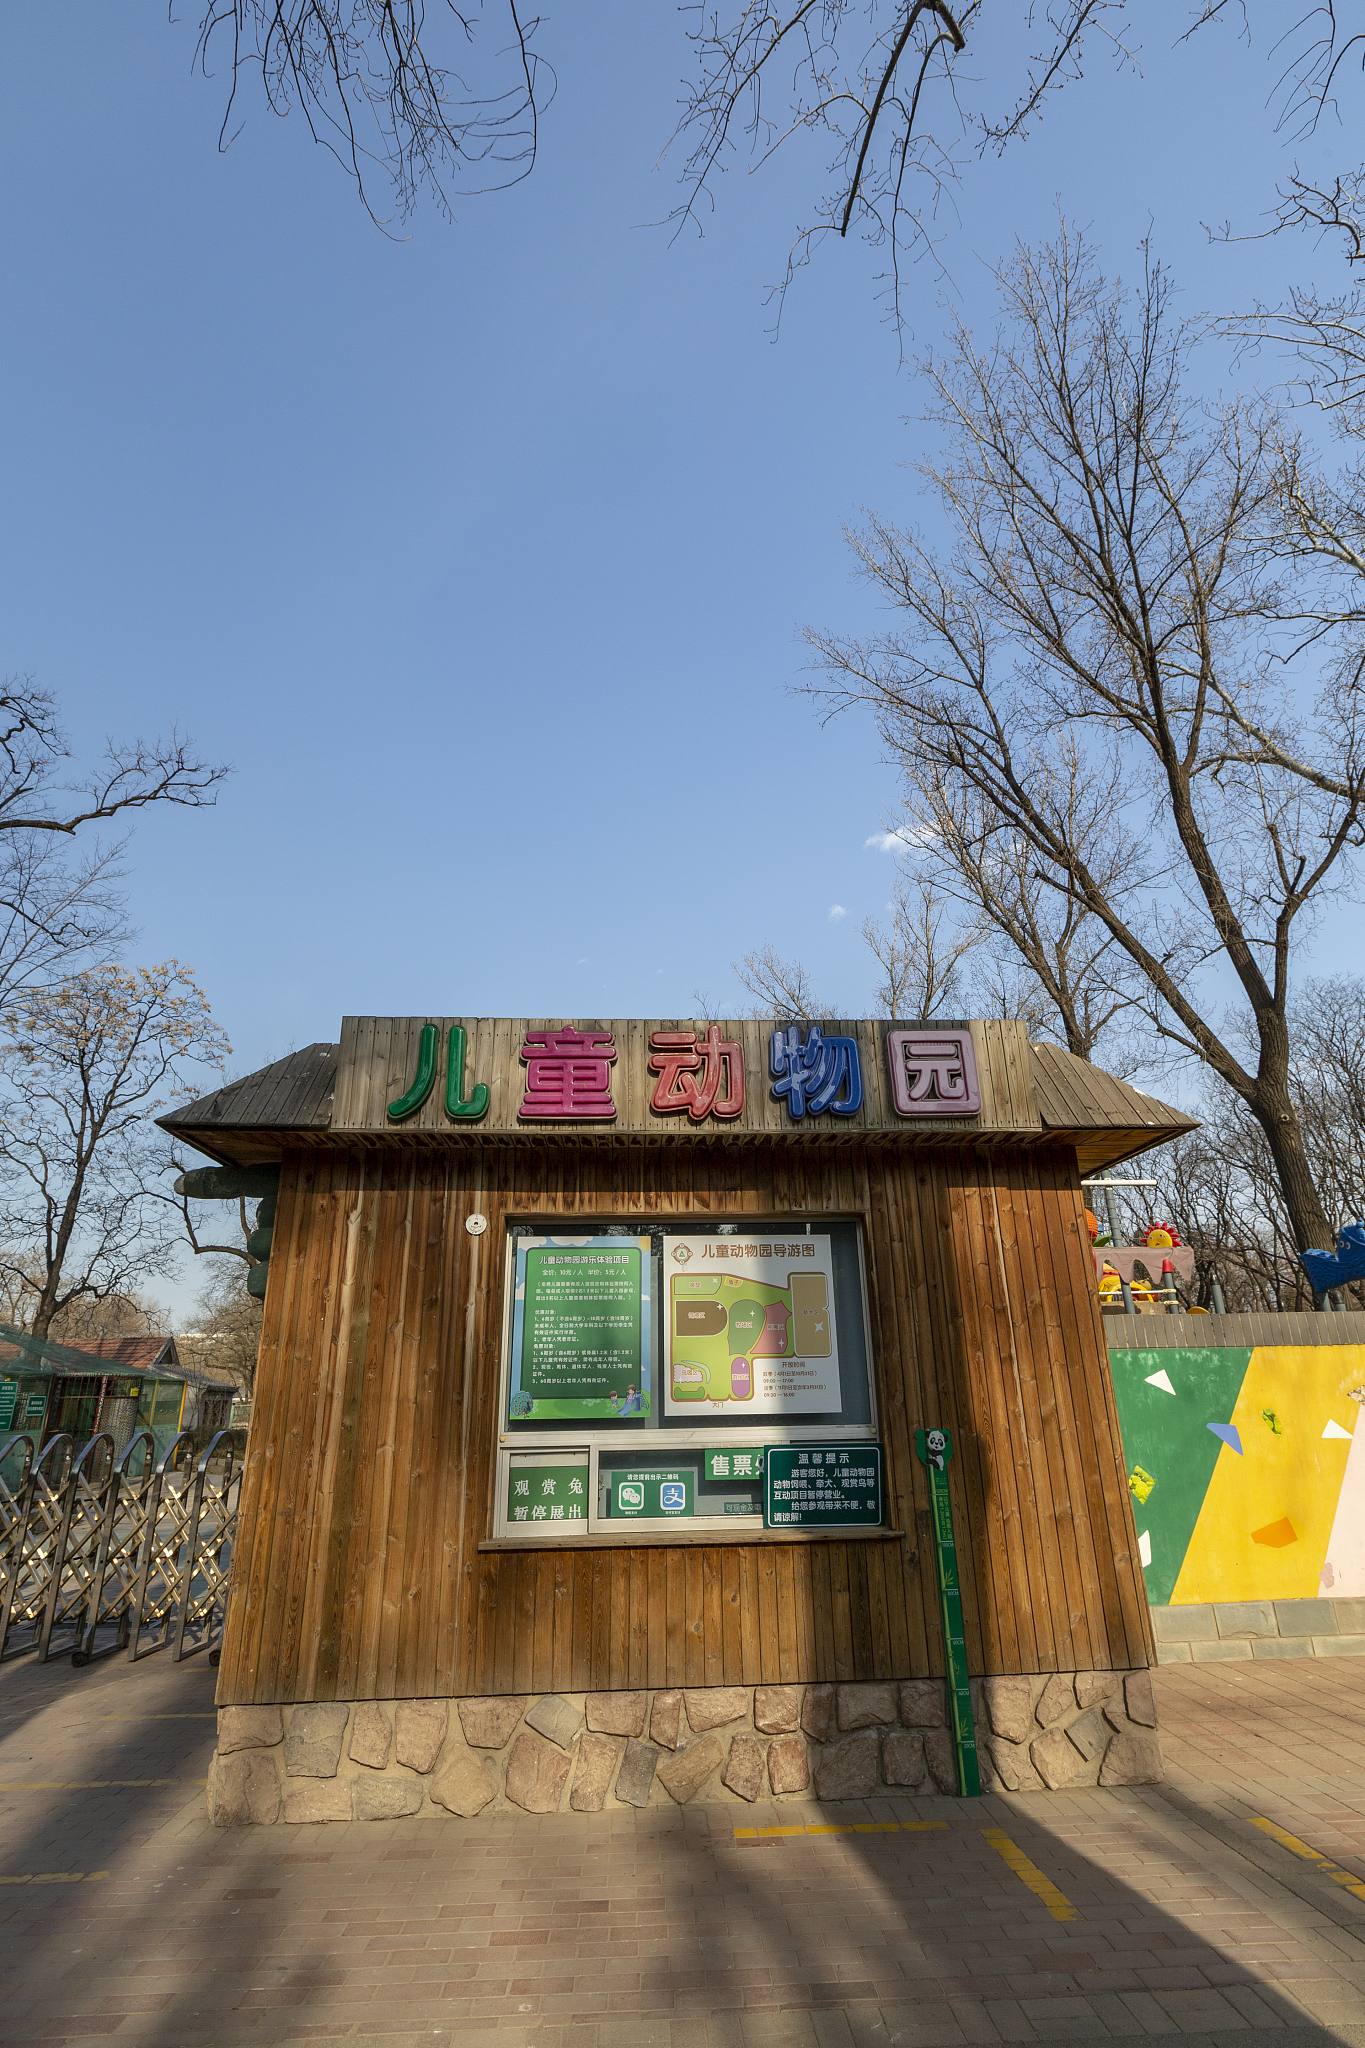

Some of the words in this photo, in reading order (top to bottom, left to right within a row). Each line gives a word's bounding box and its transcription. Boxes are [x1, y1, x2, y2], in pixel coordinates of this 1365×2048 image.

[386, 1024, 983, 1122] 儿童动物园
[702, 1243, 815, 1258] 儿童动物园导游图
[539, 1255, 630, 1265] 儿童动物园游乐体验项目
[798, 1452, 850, 1464] 温馨提示
[514, 1477, 584, 1496] 观赏兔
[513, 1504, 583, 1521] 暂停展出
